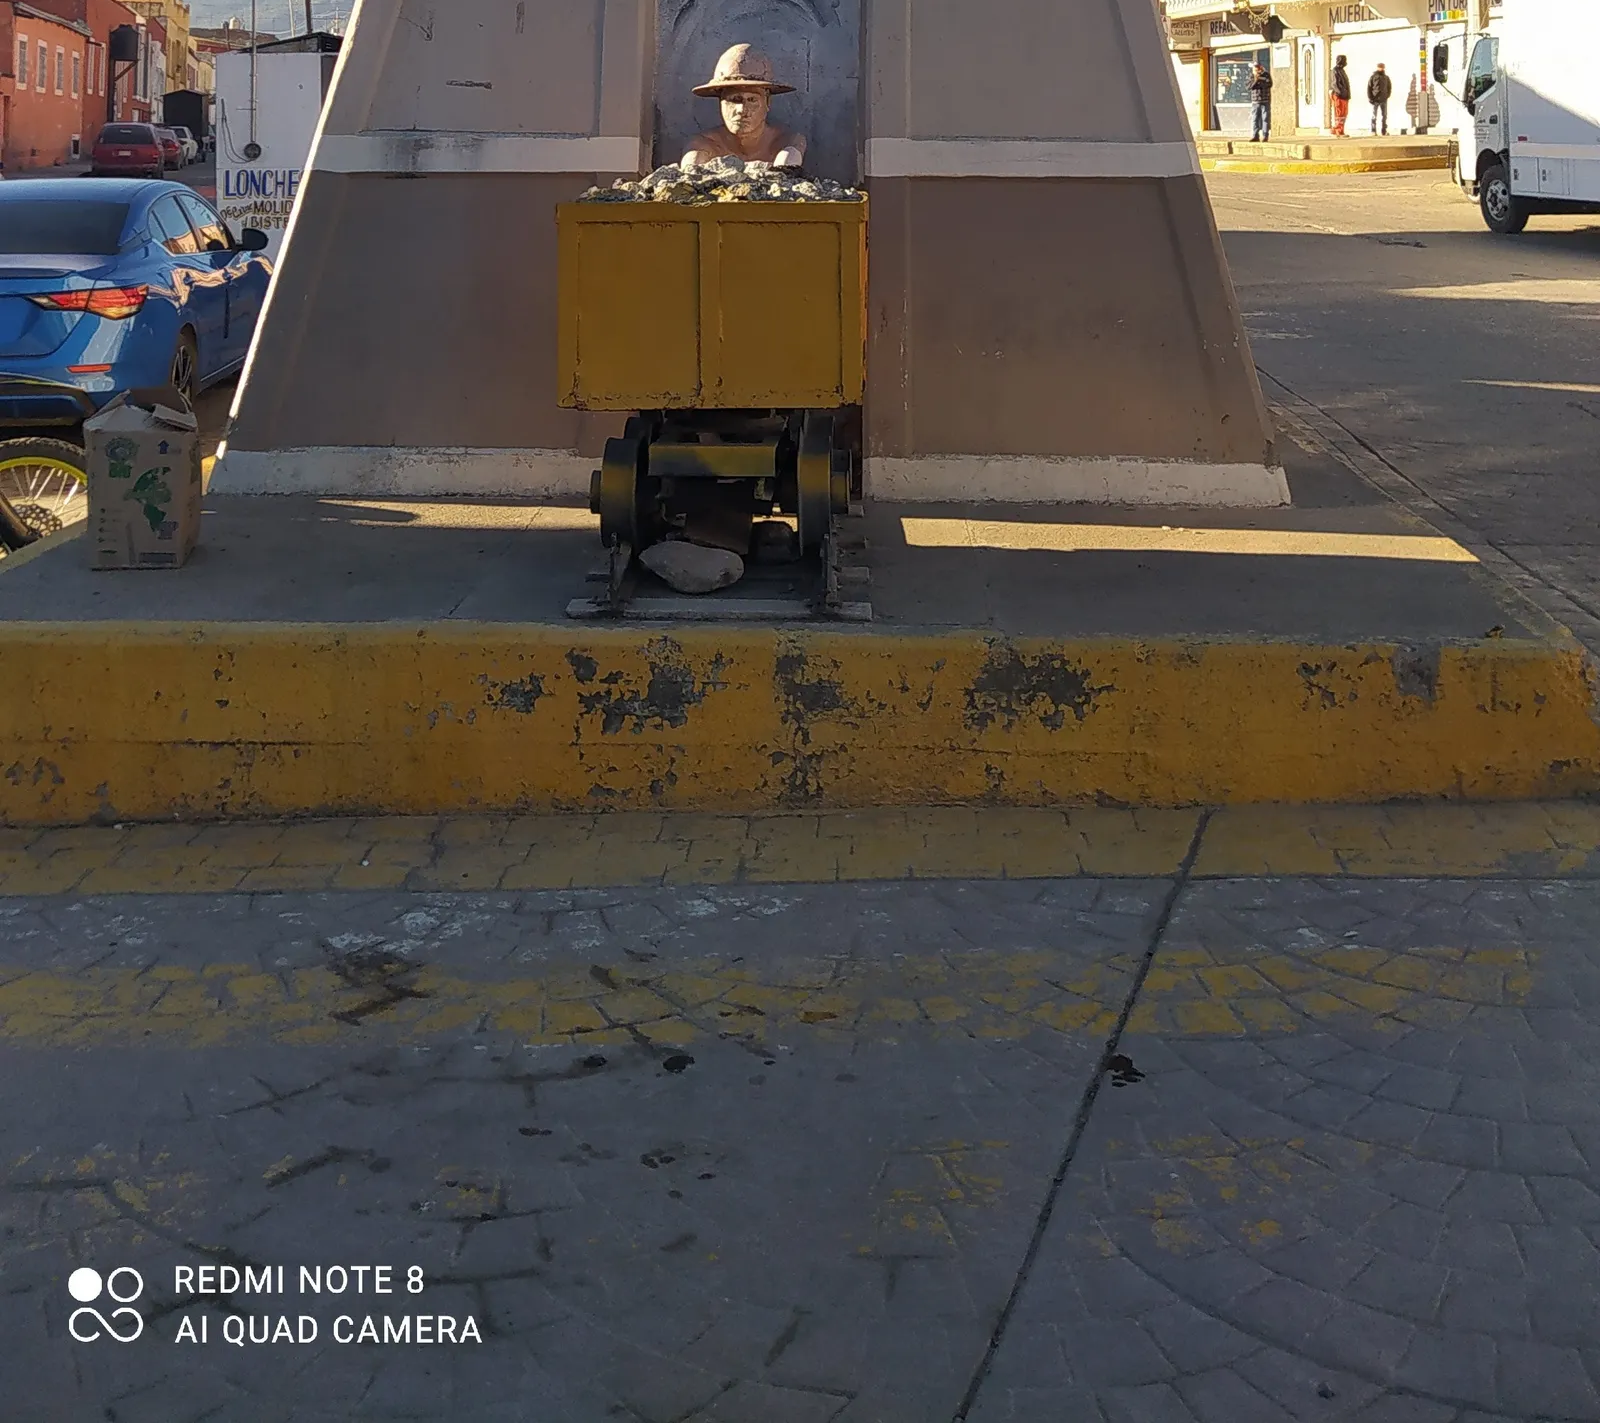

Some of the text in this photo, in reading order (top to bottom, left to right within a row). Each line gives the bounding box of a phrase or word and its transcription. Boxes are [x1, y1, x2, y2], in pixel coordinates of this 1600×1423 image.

[224, 169, 302, 198] LONCHE
[253, 200, 293, 215] MOLID
[250, 215, 289, 228] BISTE
